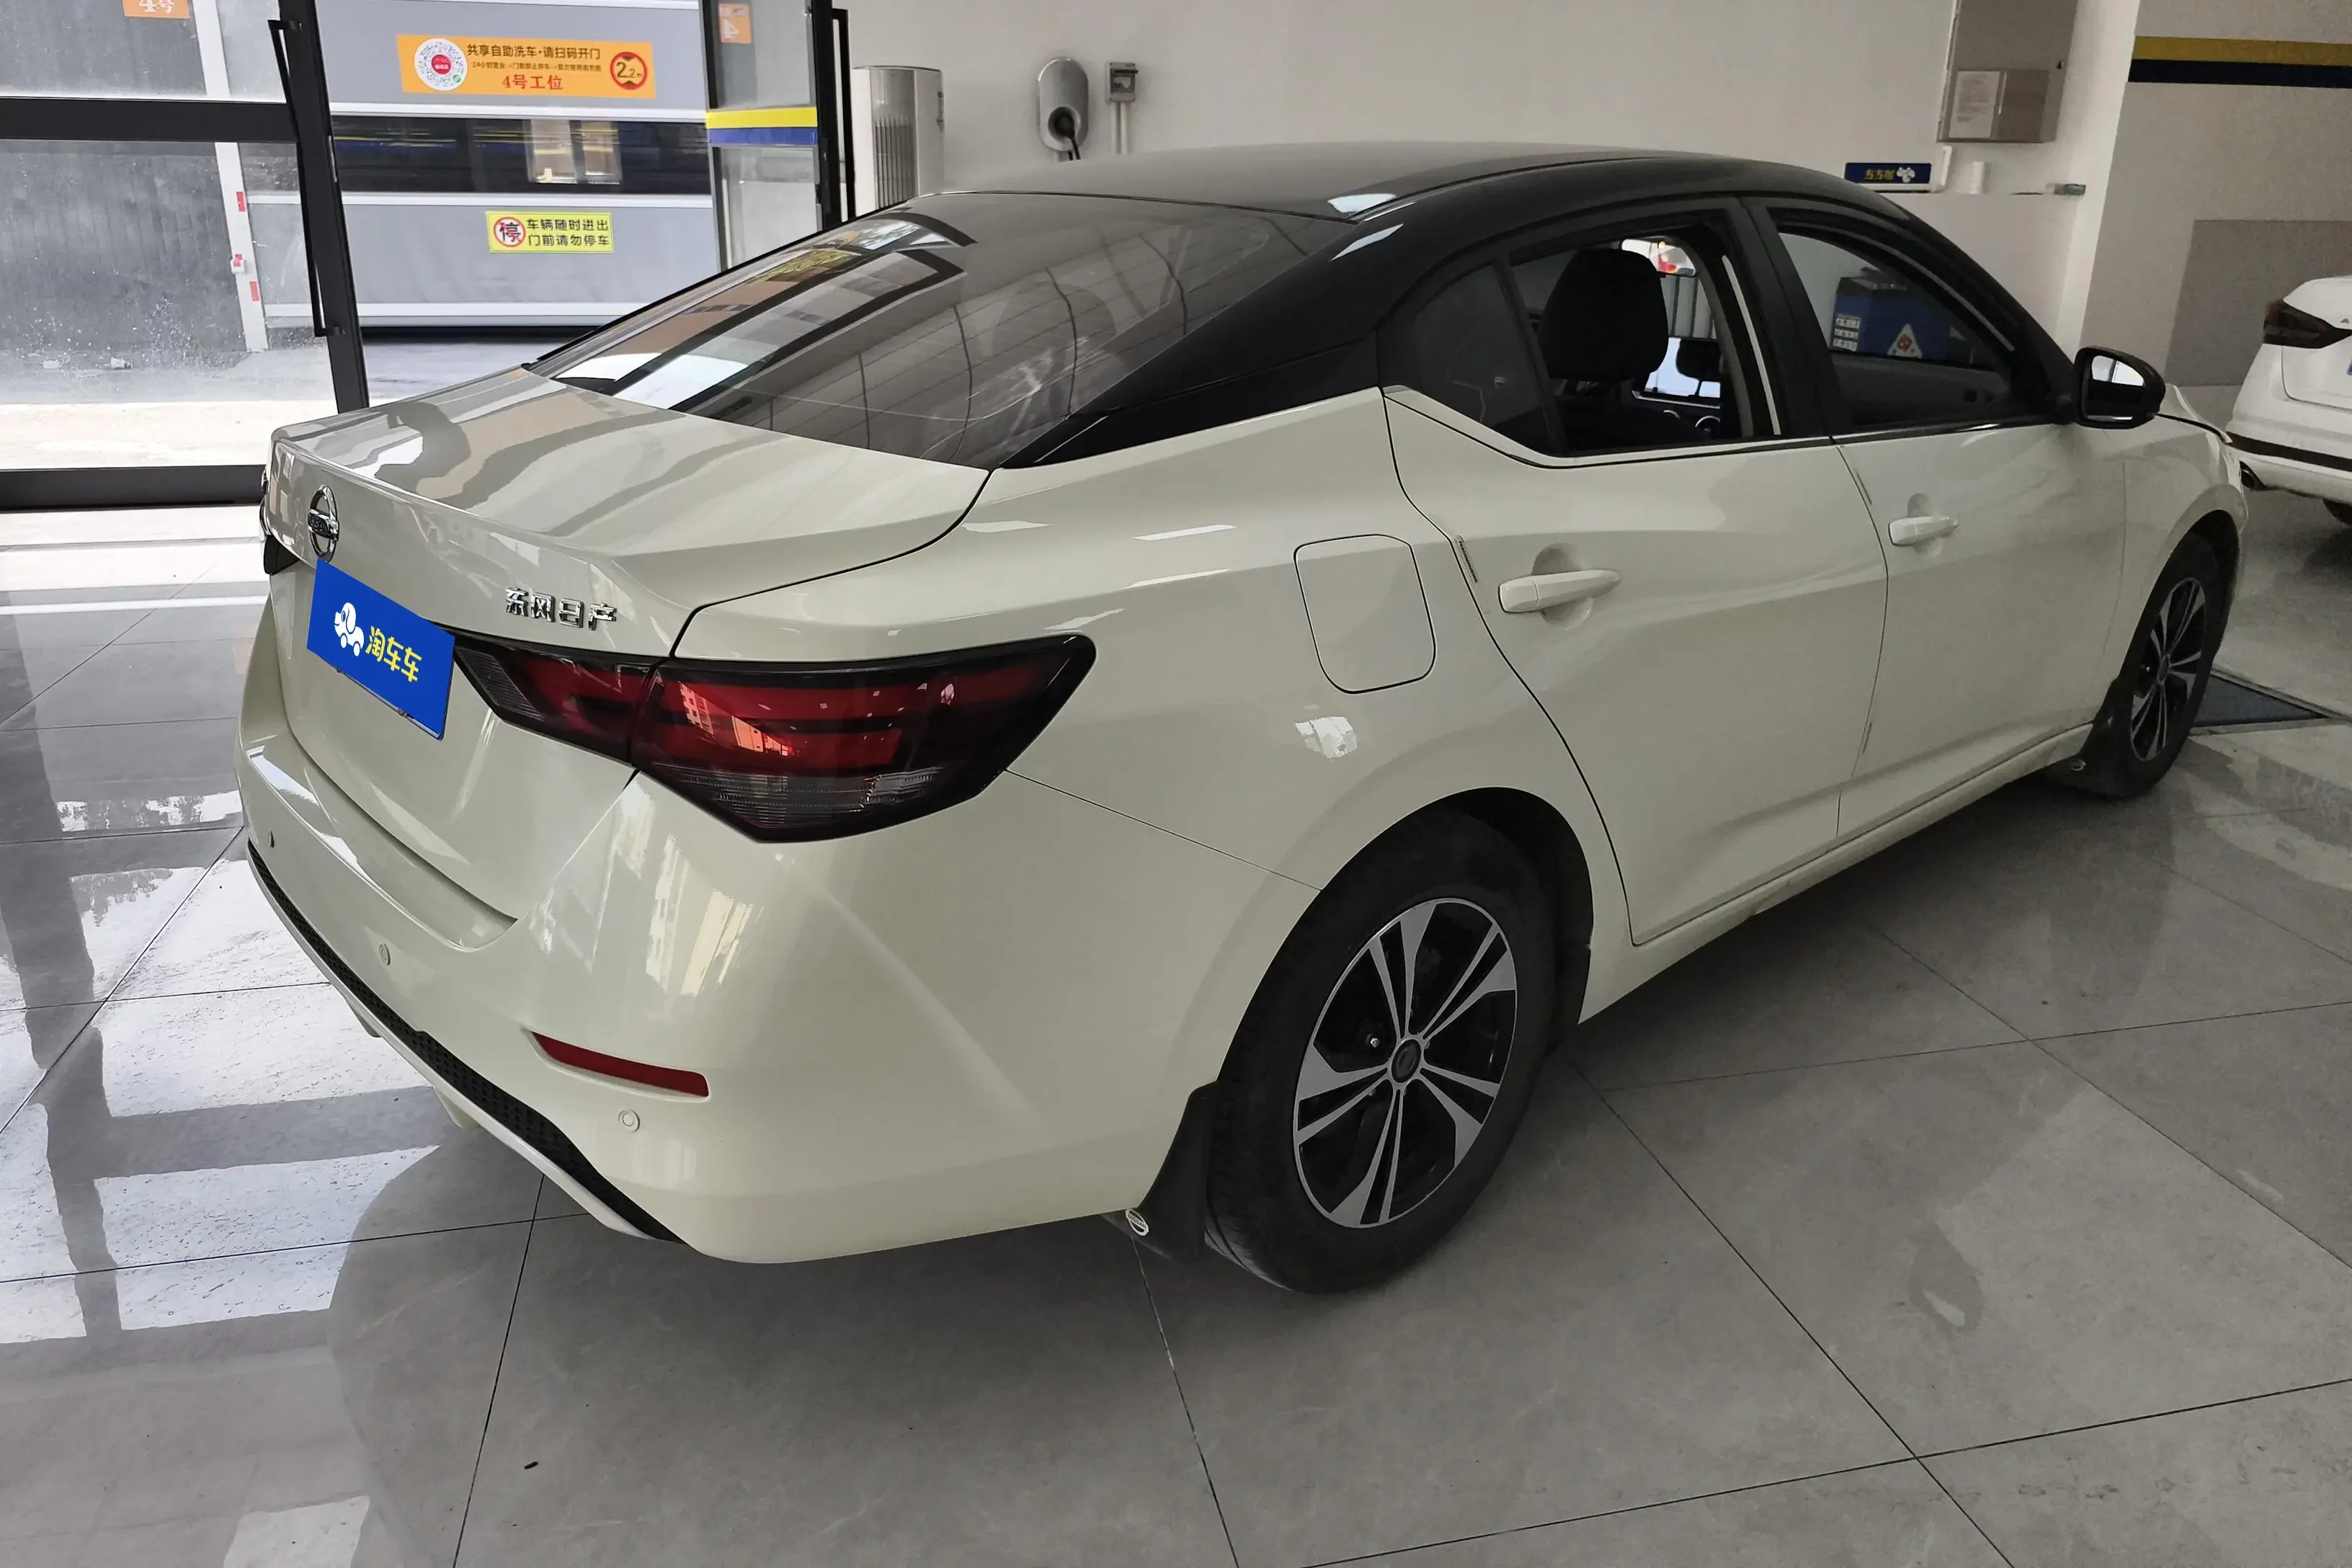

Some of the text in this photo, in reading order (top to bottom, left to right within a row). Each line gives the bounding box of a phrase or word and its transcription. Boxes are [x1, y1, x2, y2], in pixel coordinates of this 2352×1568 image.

[502, 74, 563, 90] 4号工位
[527, 219, 609, 231] 车辆随时进出
[528, 234, 610, 247] 门前请勿停车
[505, 587, 617, 631] 东风日产
